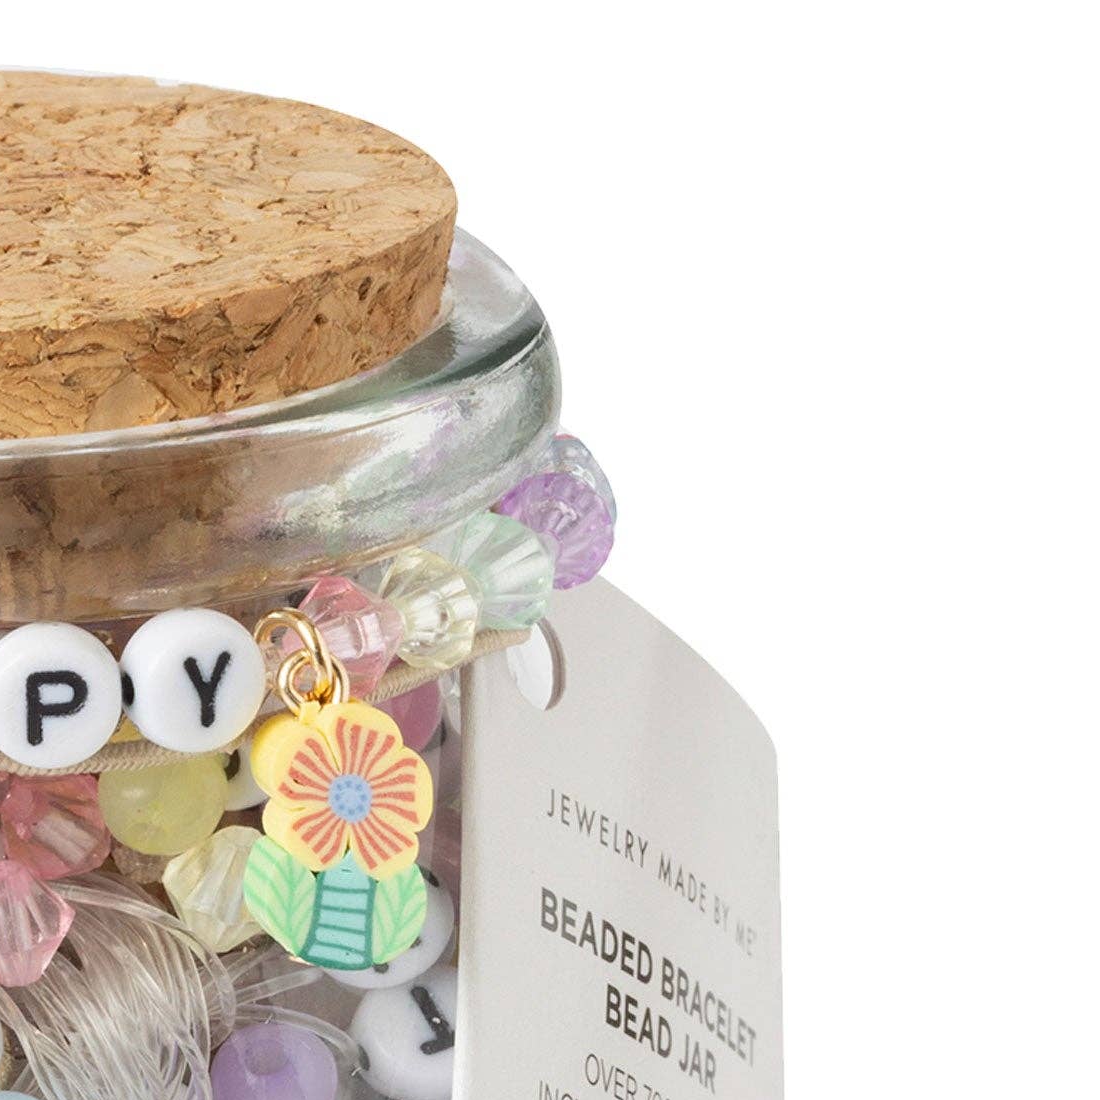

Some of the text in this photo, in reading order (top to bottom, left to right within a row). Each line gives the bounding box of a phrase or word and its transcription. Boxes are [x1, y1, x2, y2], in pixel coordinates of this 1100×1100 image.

[547, 788, 649, 869] JEWELRY
[658, 853, 707, 913] MADE
[713, 893, 731, 933] BY
[540, 887, 757, 1067] BEADED BRACELET
[605, 984, 717, 1094] BEAD JAR
